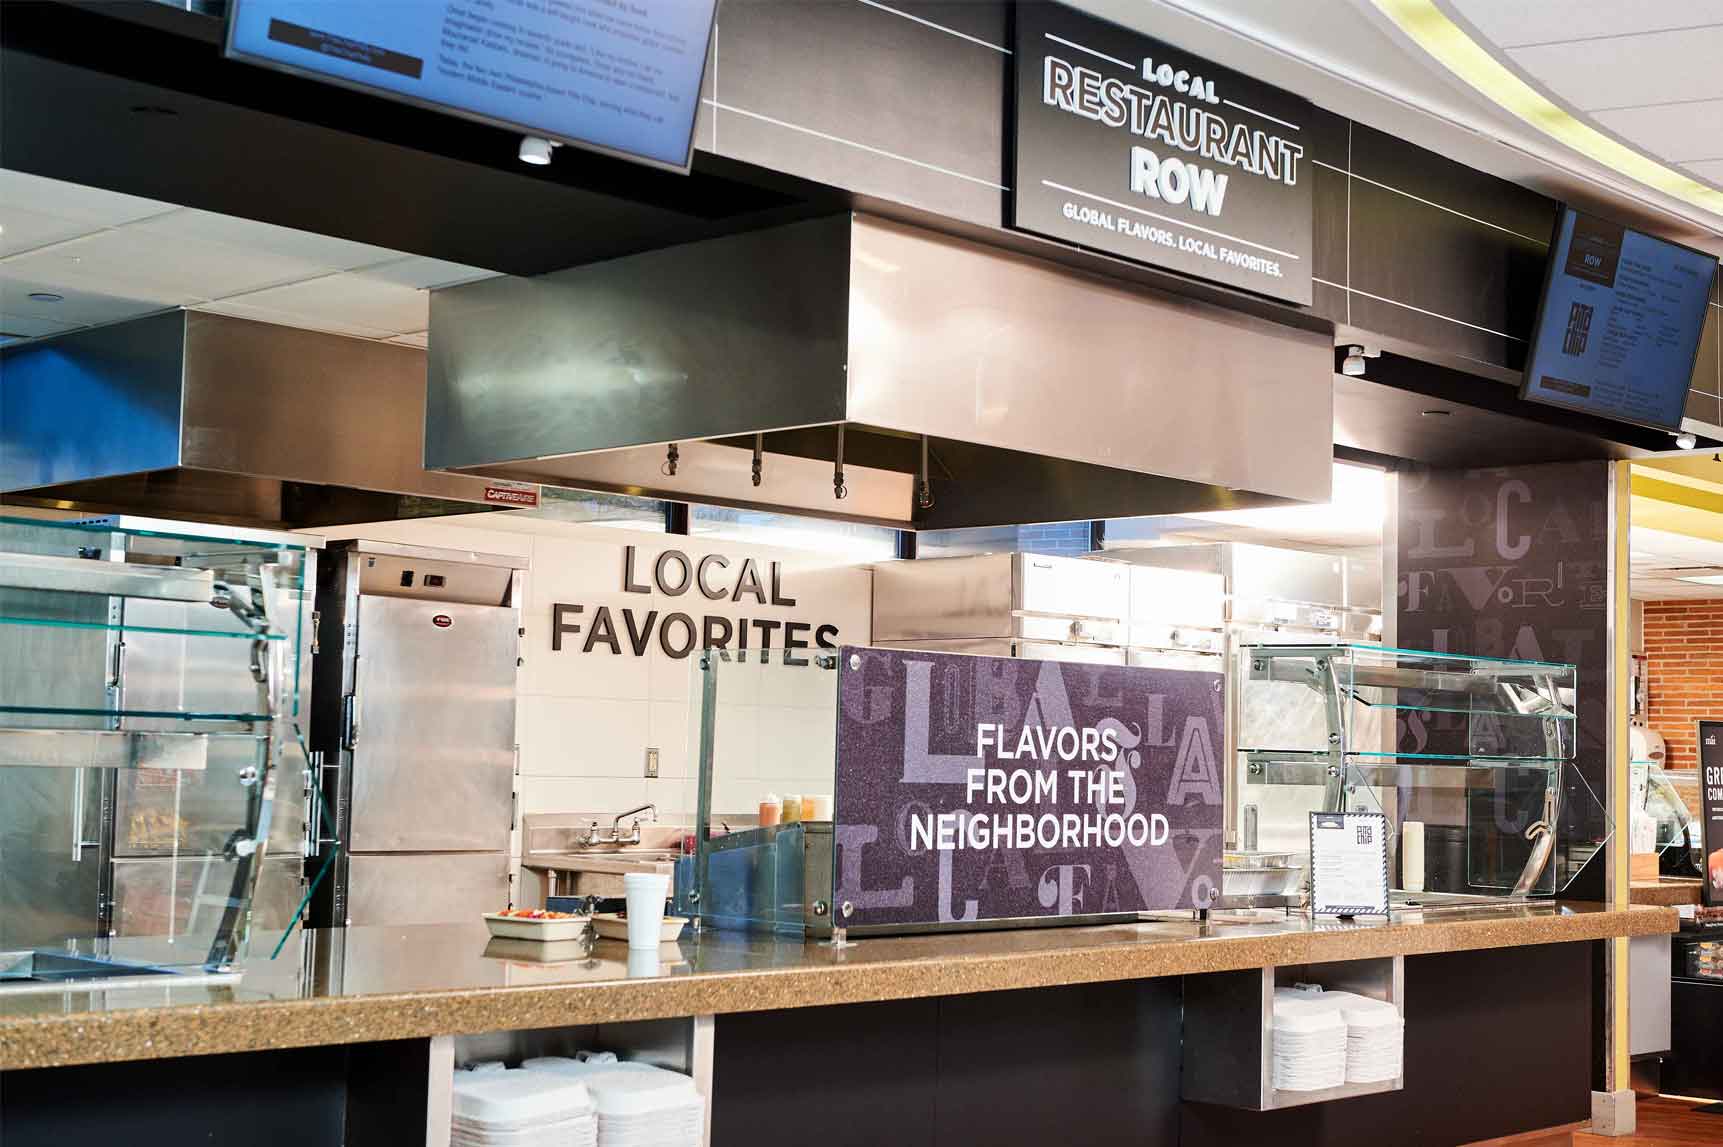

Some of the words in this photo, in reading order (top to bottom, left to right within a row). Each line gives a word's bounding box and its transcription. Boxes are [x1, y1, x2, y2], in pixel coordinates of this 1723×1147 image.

[1142, 57, 1220, 104] LOCAL
[1043, 55, 1304, 186] RESTAURANT
[1130, 146, 1229, 216] ROW
[1063, 202, 1115, 230] GLOBAL
[1117, 217, 1177, 248] FLAVORS.
[1178, 236, 1218, 260] LOCAL
[1219, 247, 1284, 277] FAVORITES.
[624, 545, 796, 607] LOCAL
[551, 603, 840, 666] FAVORITES
[977, 723, 1118, 762] FLAVORS
[966, 768, 1058, 804] FROM
[1067, 770, 1125, 804] THE
[910, 813, 1169, 850] NEIGHBORHOOD
